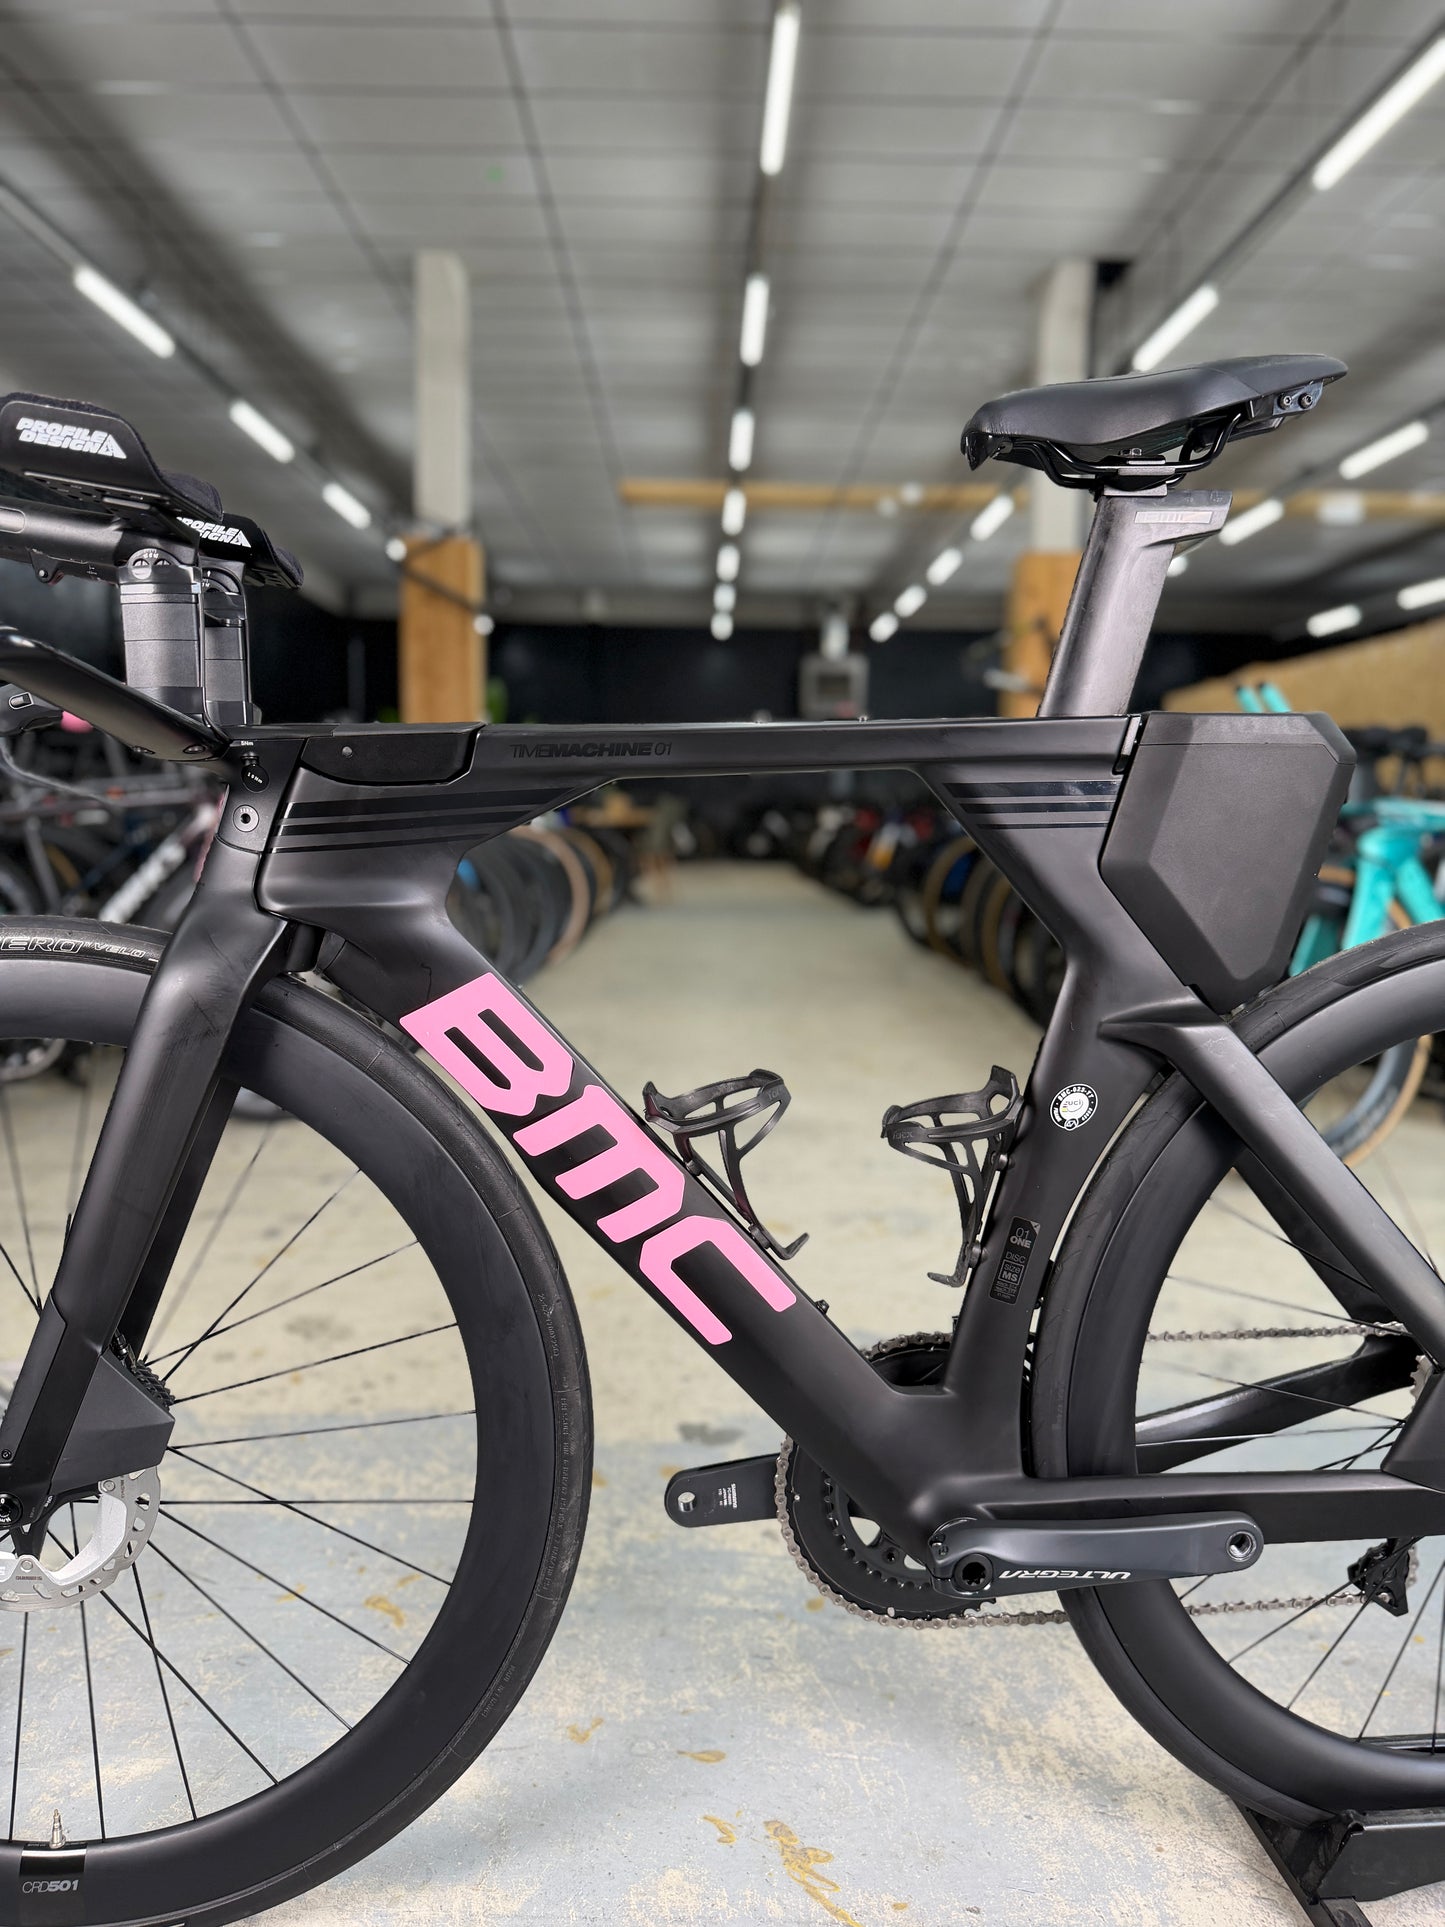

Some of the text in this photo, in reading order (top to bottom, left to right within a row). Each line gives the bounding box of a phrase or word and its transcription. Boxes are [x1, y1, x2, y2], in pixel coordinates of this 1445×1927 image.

[16, 417, 108, 443] PROFILE
[19, 429, 101, 453] DESIGN
[510, 742, 673, 758] TIMEMACHINE 01
[0, 936, 146, 958] ERO VELO
[400, 972, 797, 1345] BMC
[1015, 1227, 1030, 1239] 01
[1009, 1235, 1032, 1249] ONE
[1001, 1272, 1019, 1282] MS
[998, 1569, 1132, 1580] ULTEGRA
[22, 1879, 79, 1894] CRD501
